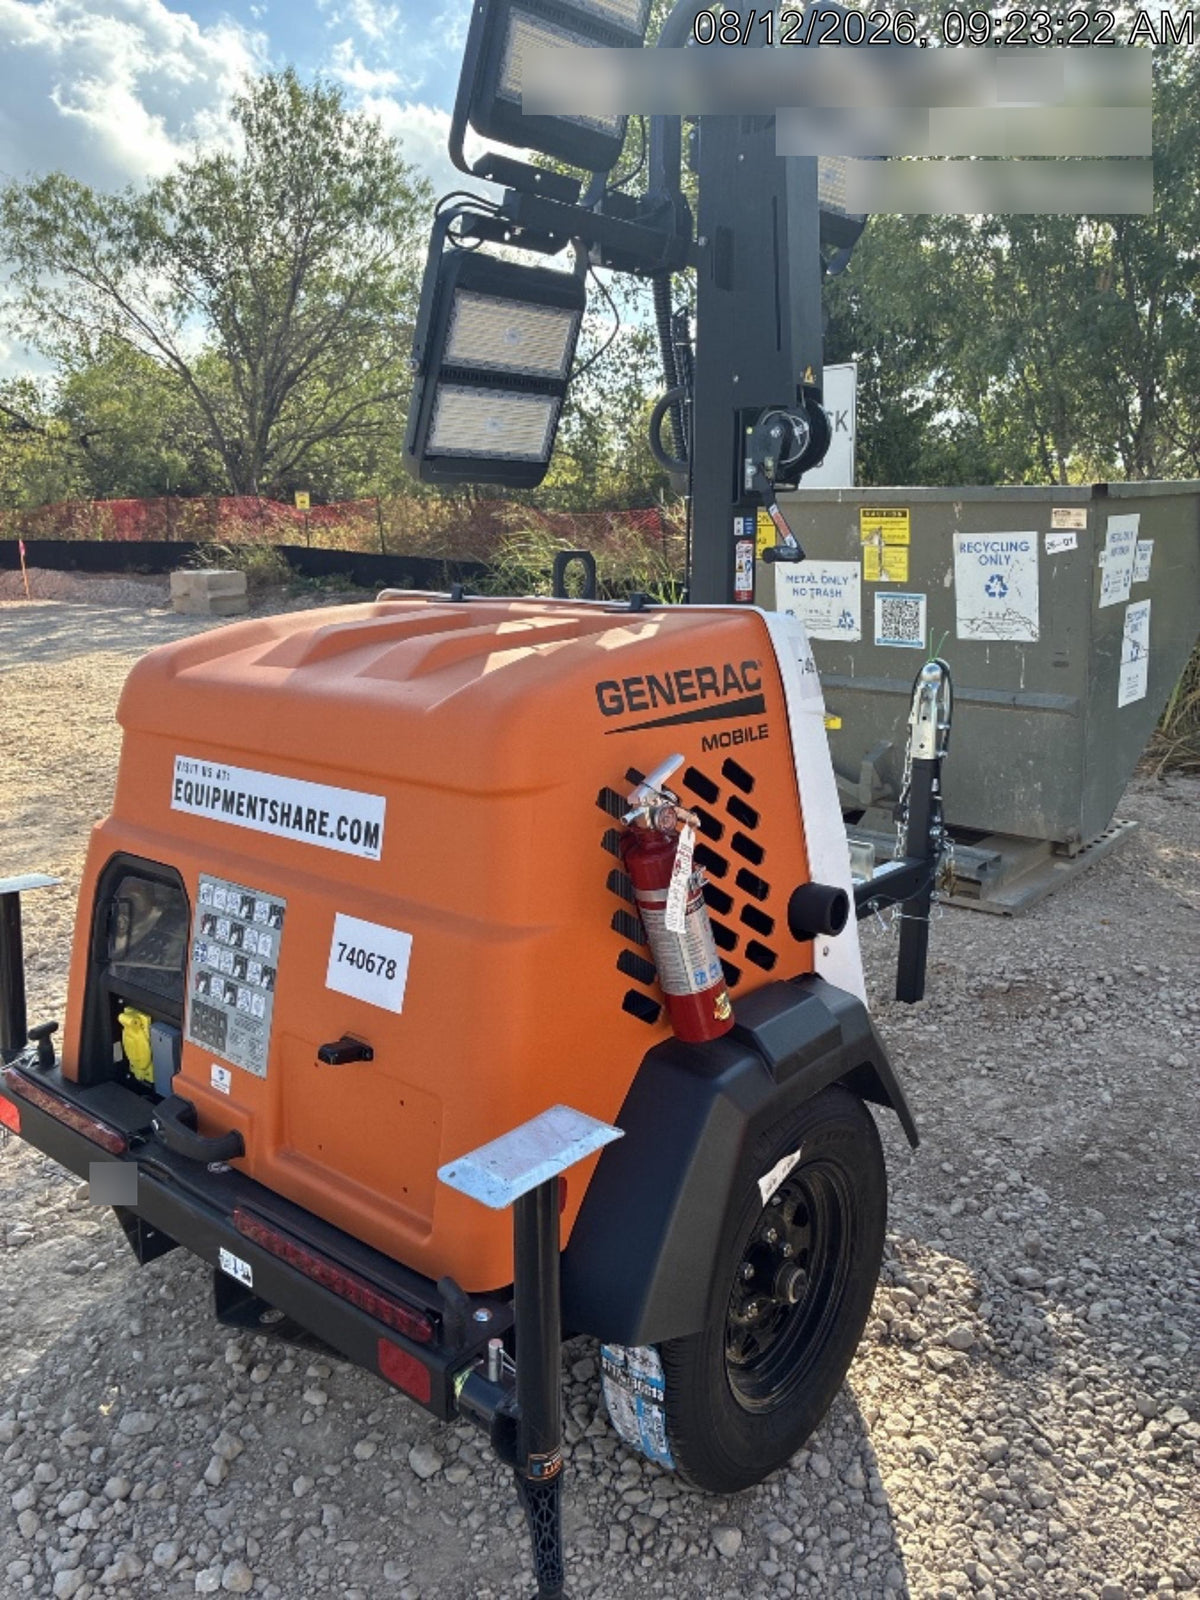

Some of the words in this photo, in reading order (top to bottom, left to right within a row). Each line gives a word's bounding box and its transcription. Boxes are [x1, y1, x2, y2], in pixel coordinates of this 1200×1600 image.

[959, 541, 1031, 554] RECYCLING
[978, 554, 1011, 566] ONLY
[785, 575, 818, 584] METAL
[820, 575, 848, 586] ONLY
[792, 587, 807, 597] NO
[809, 587, 842, 598] TRASH
[595, 659, 763, 717] GENERAC
[701, 723, 769, 752] MOBILE
[176, 760, 199, 775] VISIT
[202, 765, 213, 778] US
[174, 778, 380, 850] EQUIPMENTSHARE.COM
[337, 941, 398, 981] 740678
